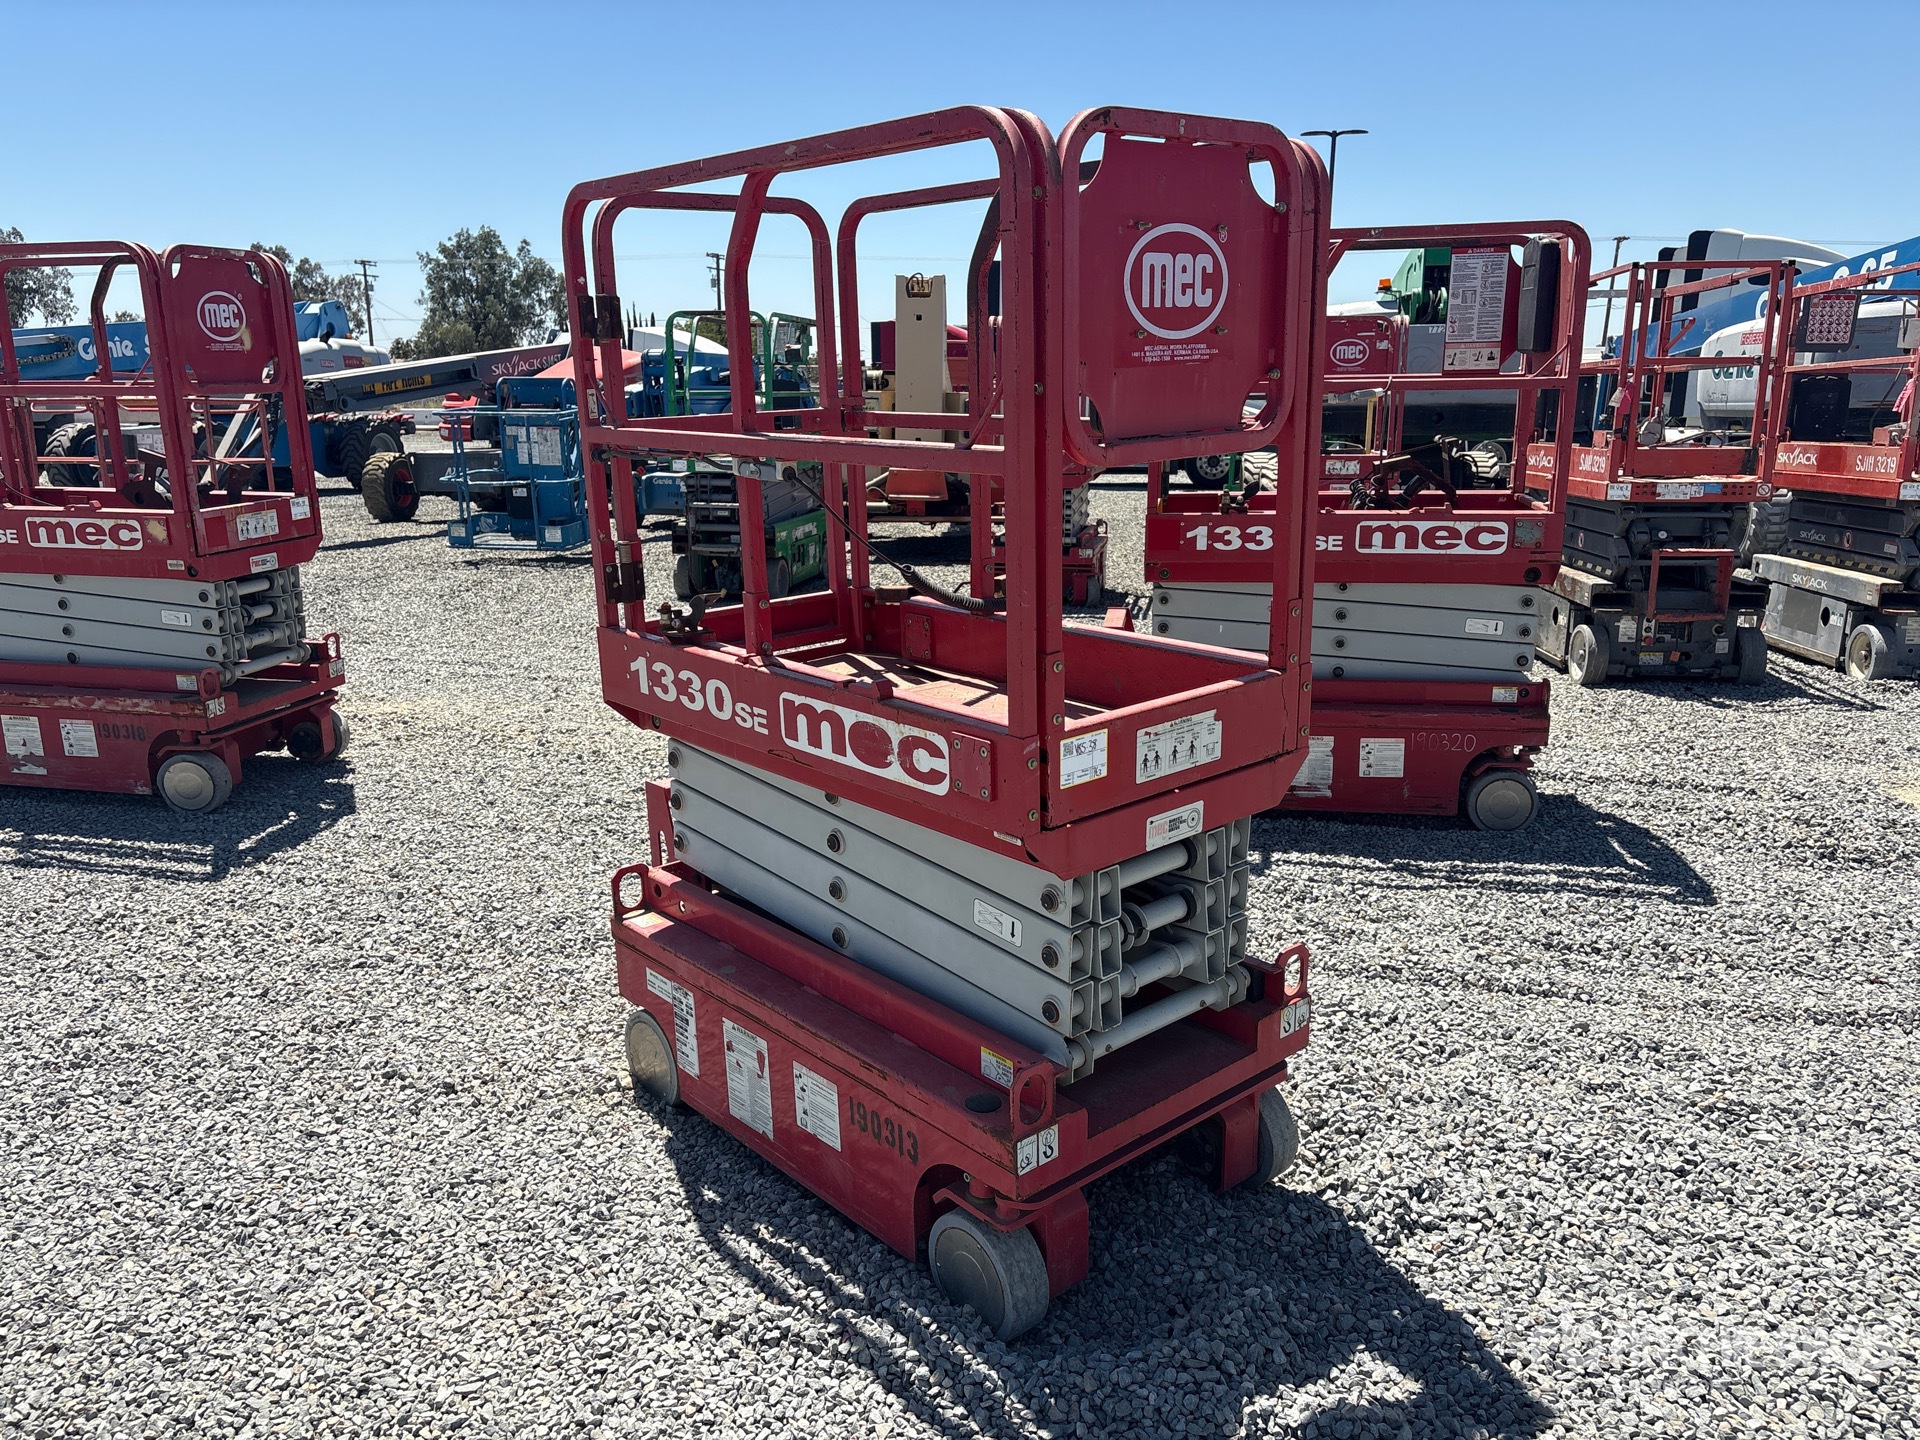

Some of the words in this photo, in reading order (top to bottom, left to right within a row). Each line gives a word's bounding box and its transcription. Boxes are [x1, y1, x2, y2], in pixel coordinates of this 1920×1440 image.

[1142, 252, 1214, 307] mec
[204, 303, 240, 328] mec
[78, 336, 138, 361] Gnie
[1336, 345, 1363, 360] mec
[491, 355, 542, 376] SKYJACK
[1777, 447, 1818, 466] SKYJACK
[1875, 456, 1897, 473] 3219
[27, 520, 141, 547] mec
[1358, 524, 1506, 551] mec
[1800, 528, 1826, 542] SKYJACK
[1792, 572, 1828, 590] SKYJACK
[1411, 732, 1477, 753] 190320
[736, 1026, 758, 1043] WARNING
[849, 1095, 919, 1167] 190313
